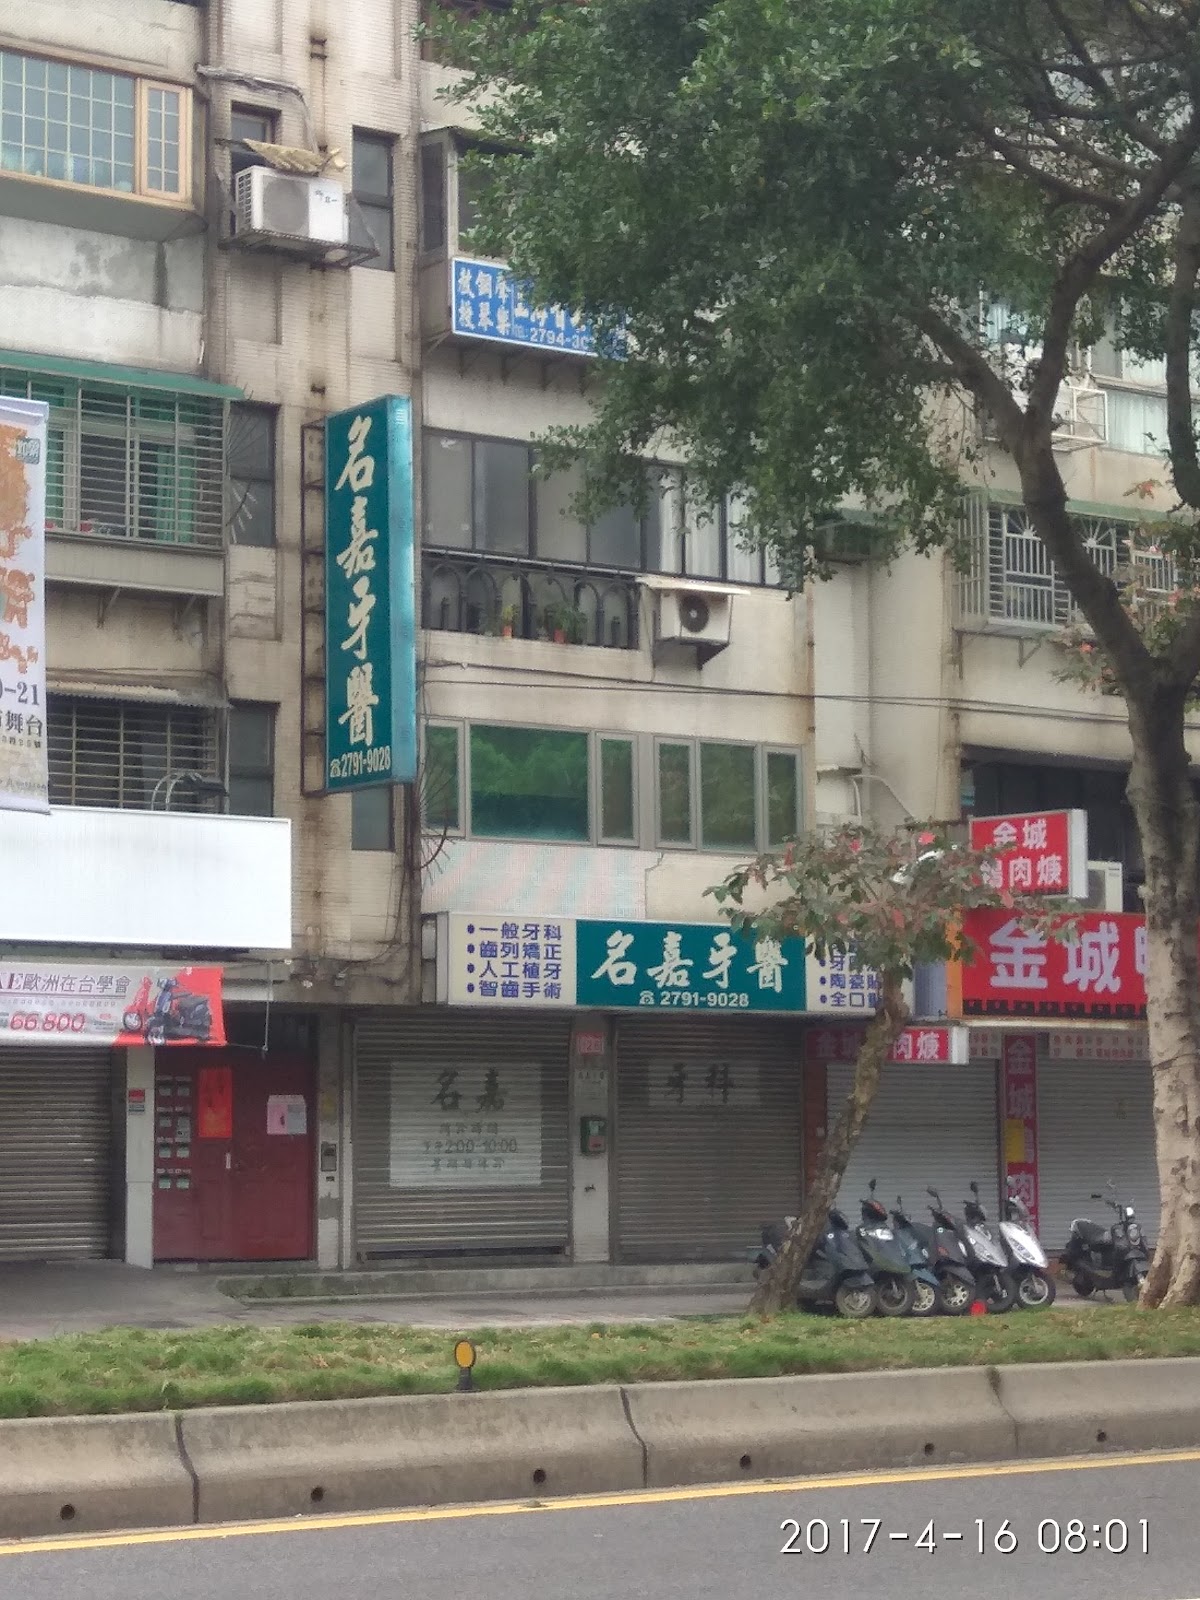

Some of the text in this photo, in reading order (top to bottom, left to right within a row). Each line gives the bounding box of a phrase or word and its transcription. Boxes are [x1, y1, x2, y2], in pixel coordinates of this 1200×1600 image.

[334, 415, 381, 747] 名嘉牙醫
[0, 711, 43, 737] 舞台
[341, 745, 391, 776] 2791-9028
[993, 819, 1047, 850] 金城
[479, 922, 562, 941] 一般牙科
[591, 930, 789, 993] 名嘉牙醫
[989, 918, 1147, 993] 金城
[479, 961, 562, 980] 人工植牙
[479, 980, 562, 999] 智齒手術
[660, 991, 749, 1008] 2791-9028
